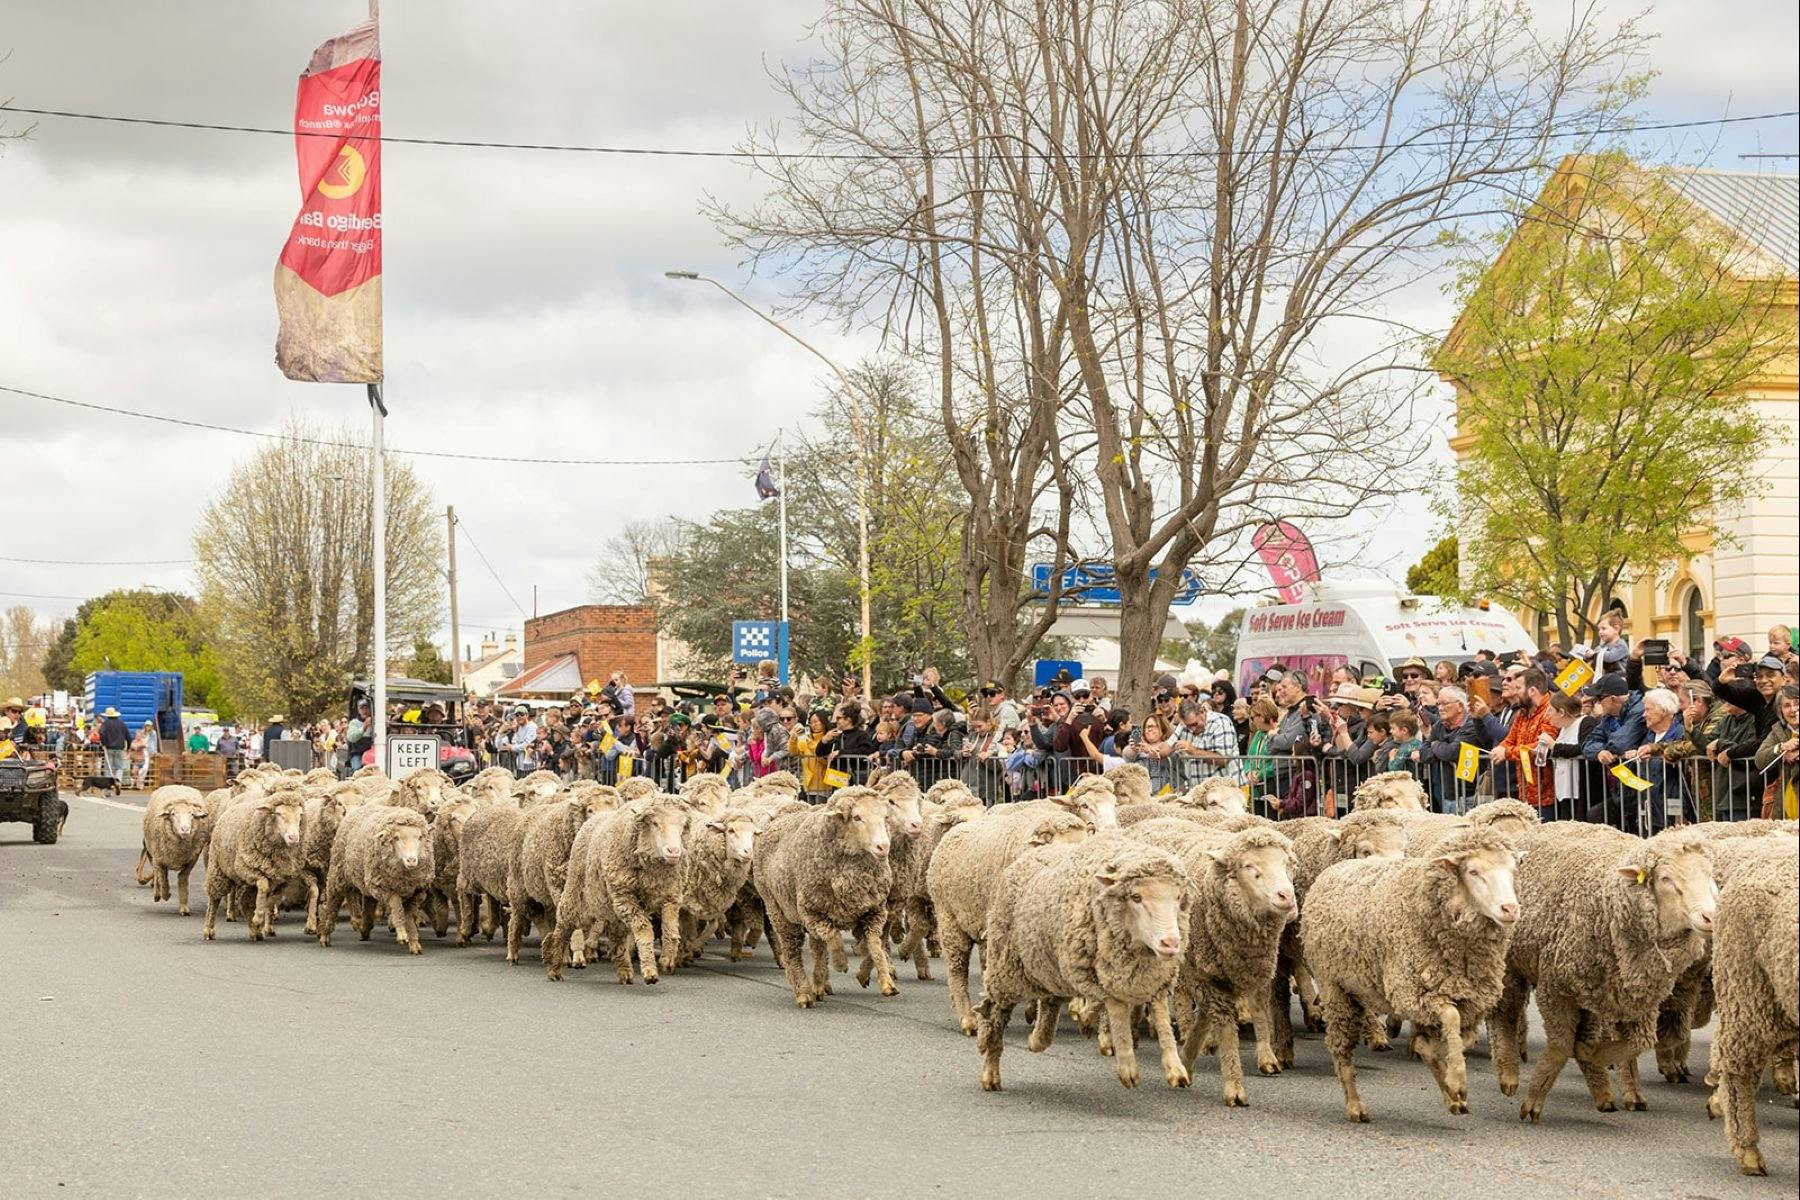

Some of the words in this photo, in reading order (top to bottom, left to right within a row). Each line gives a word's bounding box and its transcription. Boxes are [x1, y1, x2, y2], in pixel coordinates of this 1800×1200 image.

[1249, 614, 1268, 632] Soft
[1267, 612, 1295, 631] Serve
[1296, 609, 1311, 629] Ice
[1312, 607, 1346, 627] Cream
[1385, 623, 1411, 632] Soft
[740, 649, 769, 657] Police
[397, 744, 430, 753] KEEP
[399, 757, 428, 767] LEFT
